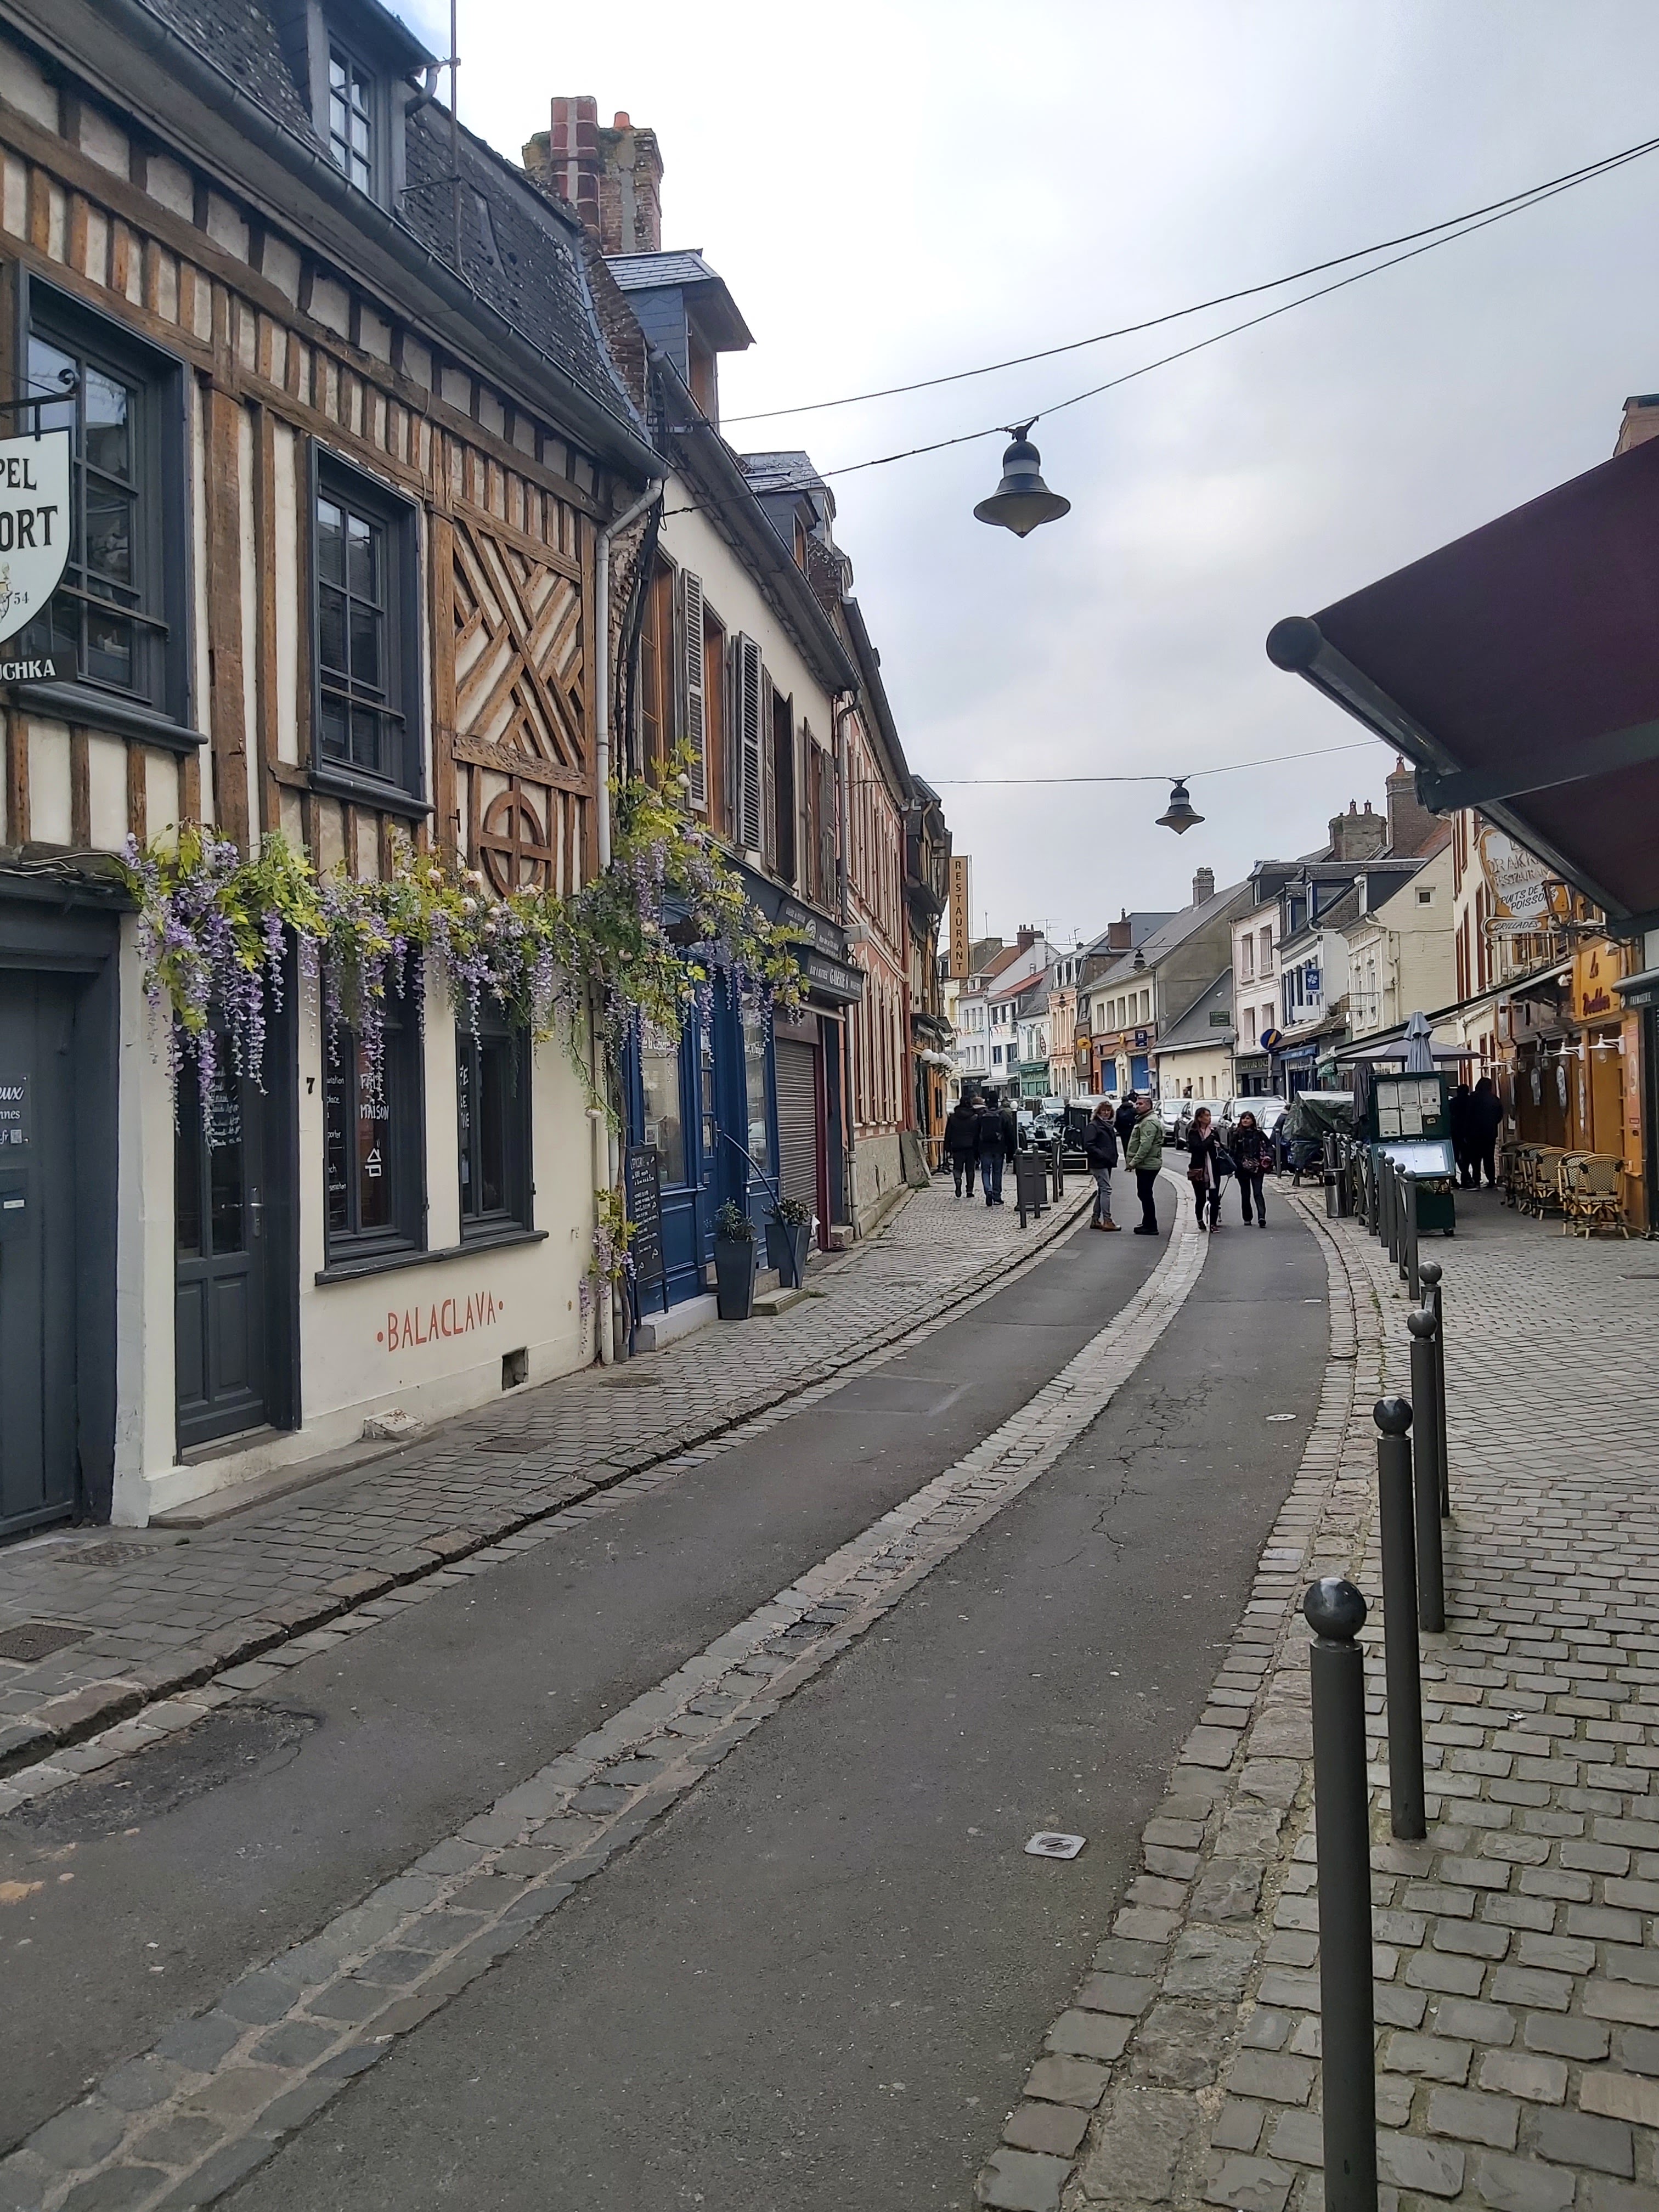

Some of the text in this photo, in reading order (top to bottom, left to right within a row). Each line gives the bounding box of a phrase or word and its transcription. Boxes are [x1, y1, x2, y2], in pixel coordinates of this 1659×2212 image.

[0, 658, 56, 681] CHKA
[1511, 889, 1556, 911] POISSOS
[955, 861, 963, 971] RESTAURANT
[306, 1077, 315, 1094] 7
[360, 1104, 389, 1121] MAISON
[388, 1290, 496, 1352] BALACLAVA
